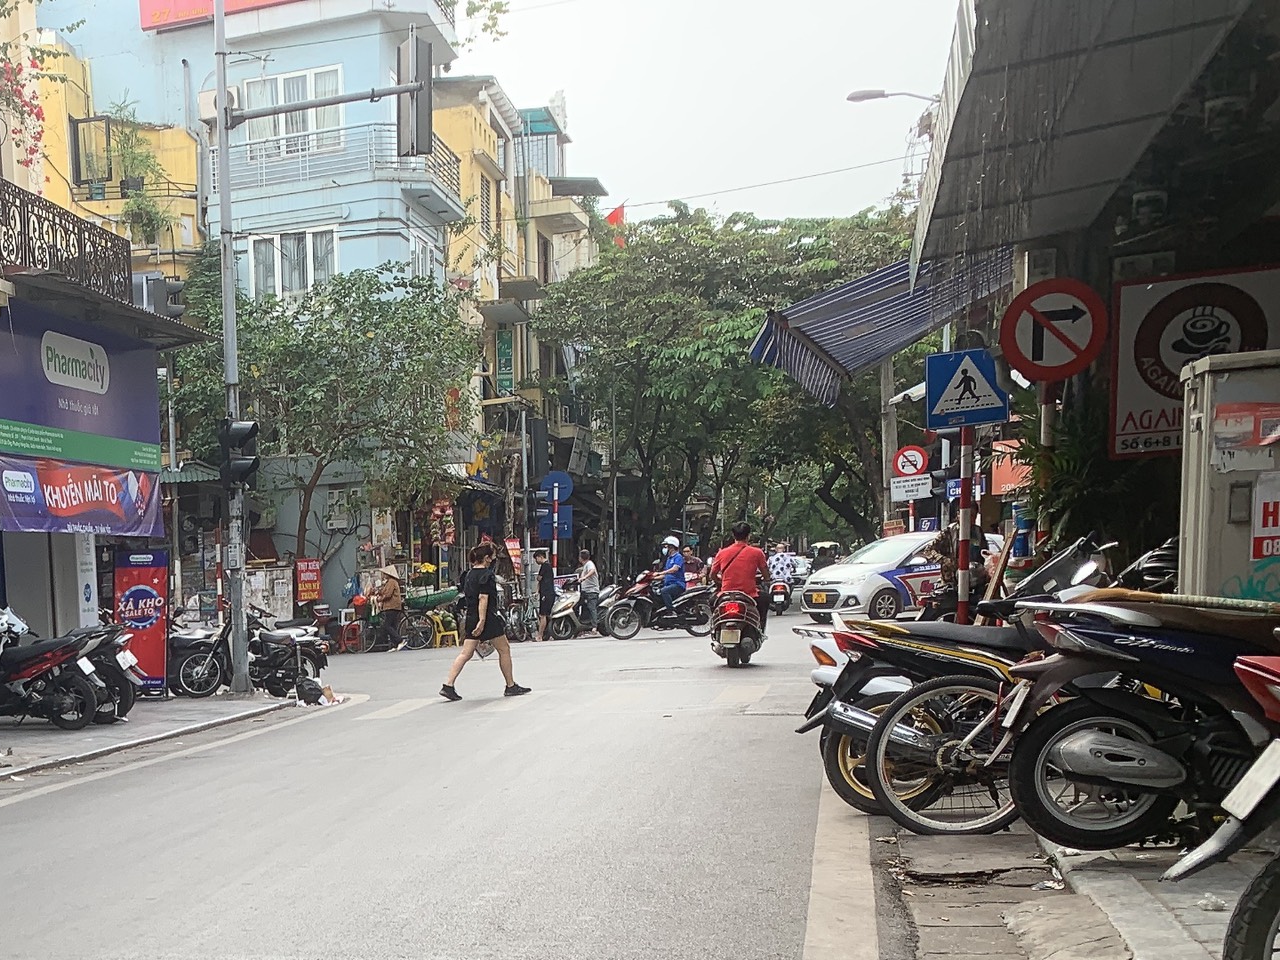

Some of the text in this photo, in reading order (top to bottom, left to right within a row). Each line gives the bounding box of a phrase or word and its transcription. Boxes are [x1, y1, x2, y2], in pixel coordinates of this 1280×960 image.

[152, 8, 170, 24] 27
[45, 345, 105, 390] Pharmacity
[4, 473, 33, 491] Pharmacity
[43, 473, 118, 509] KHUYẾN MÃI TO
[949, 487, 962, 496] CH
[117, 596, 165, 612] XẢ KHO
[124, 607, 154, 618] SALE TO
